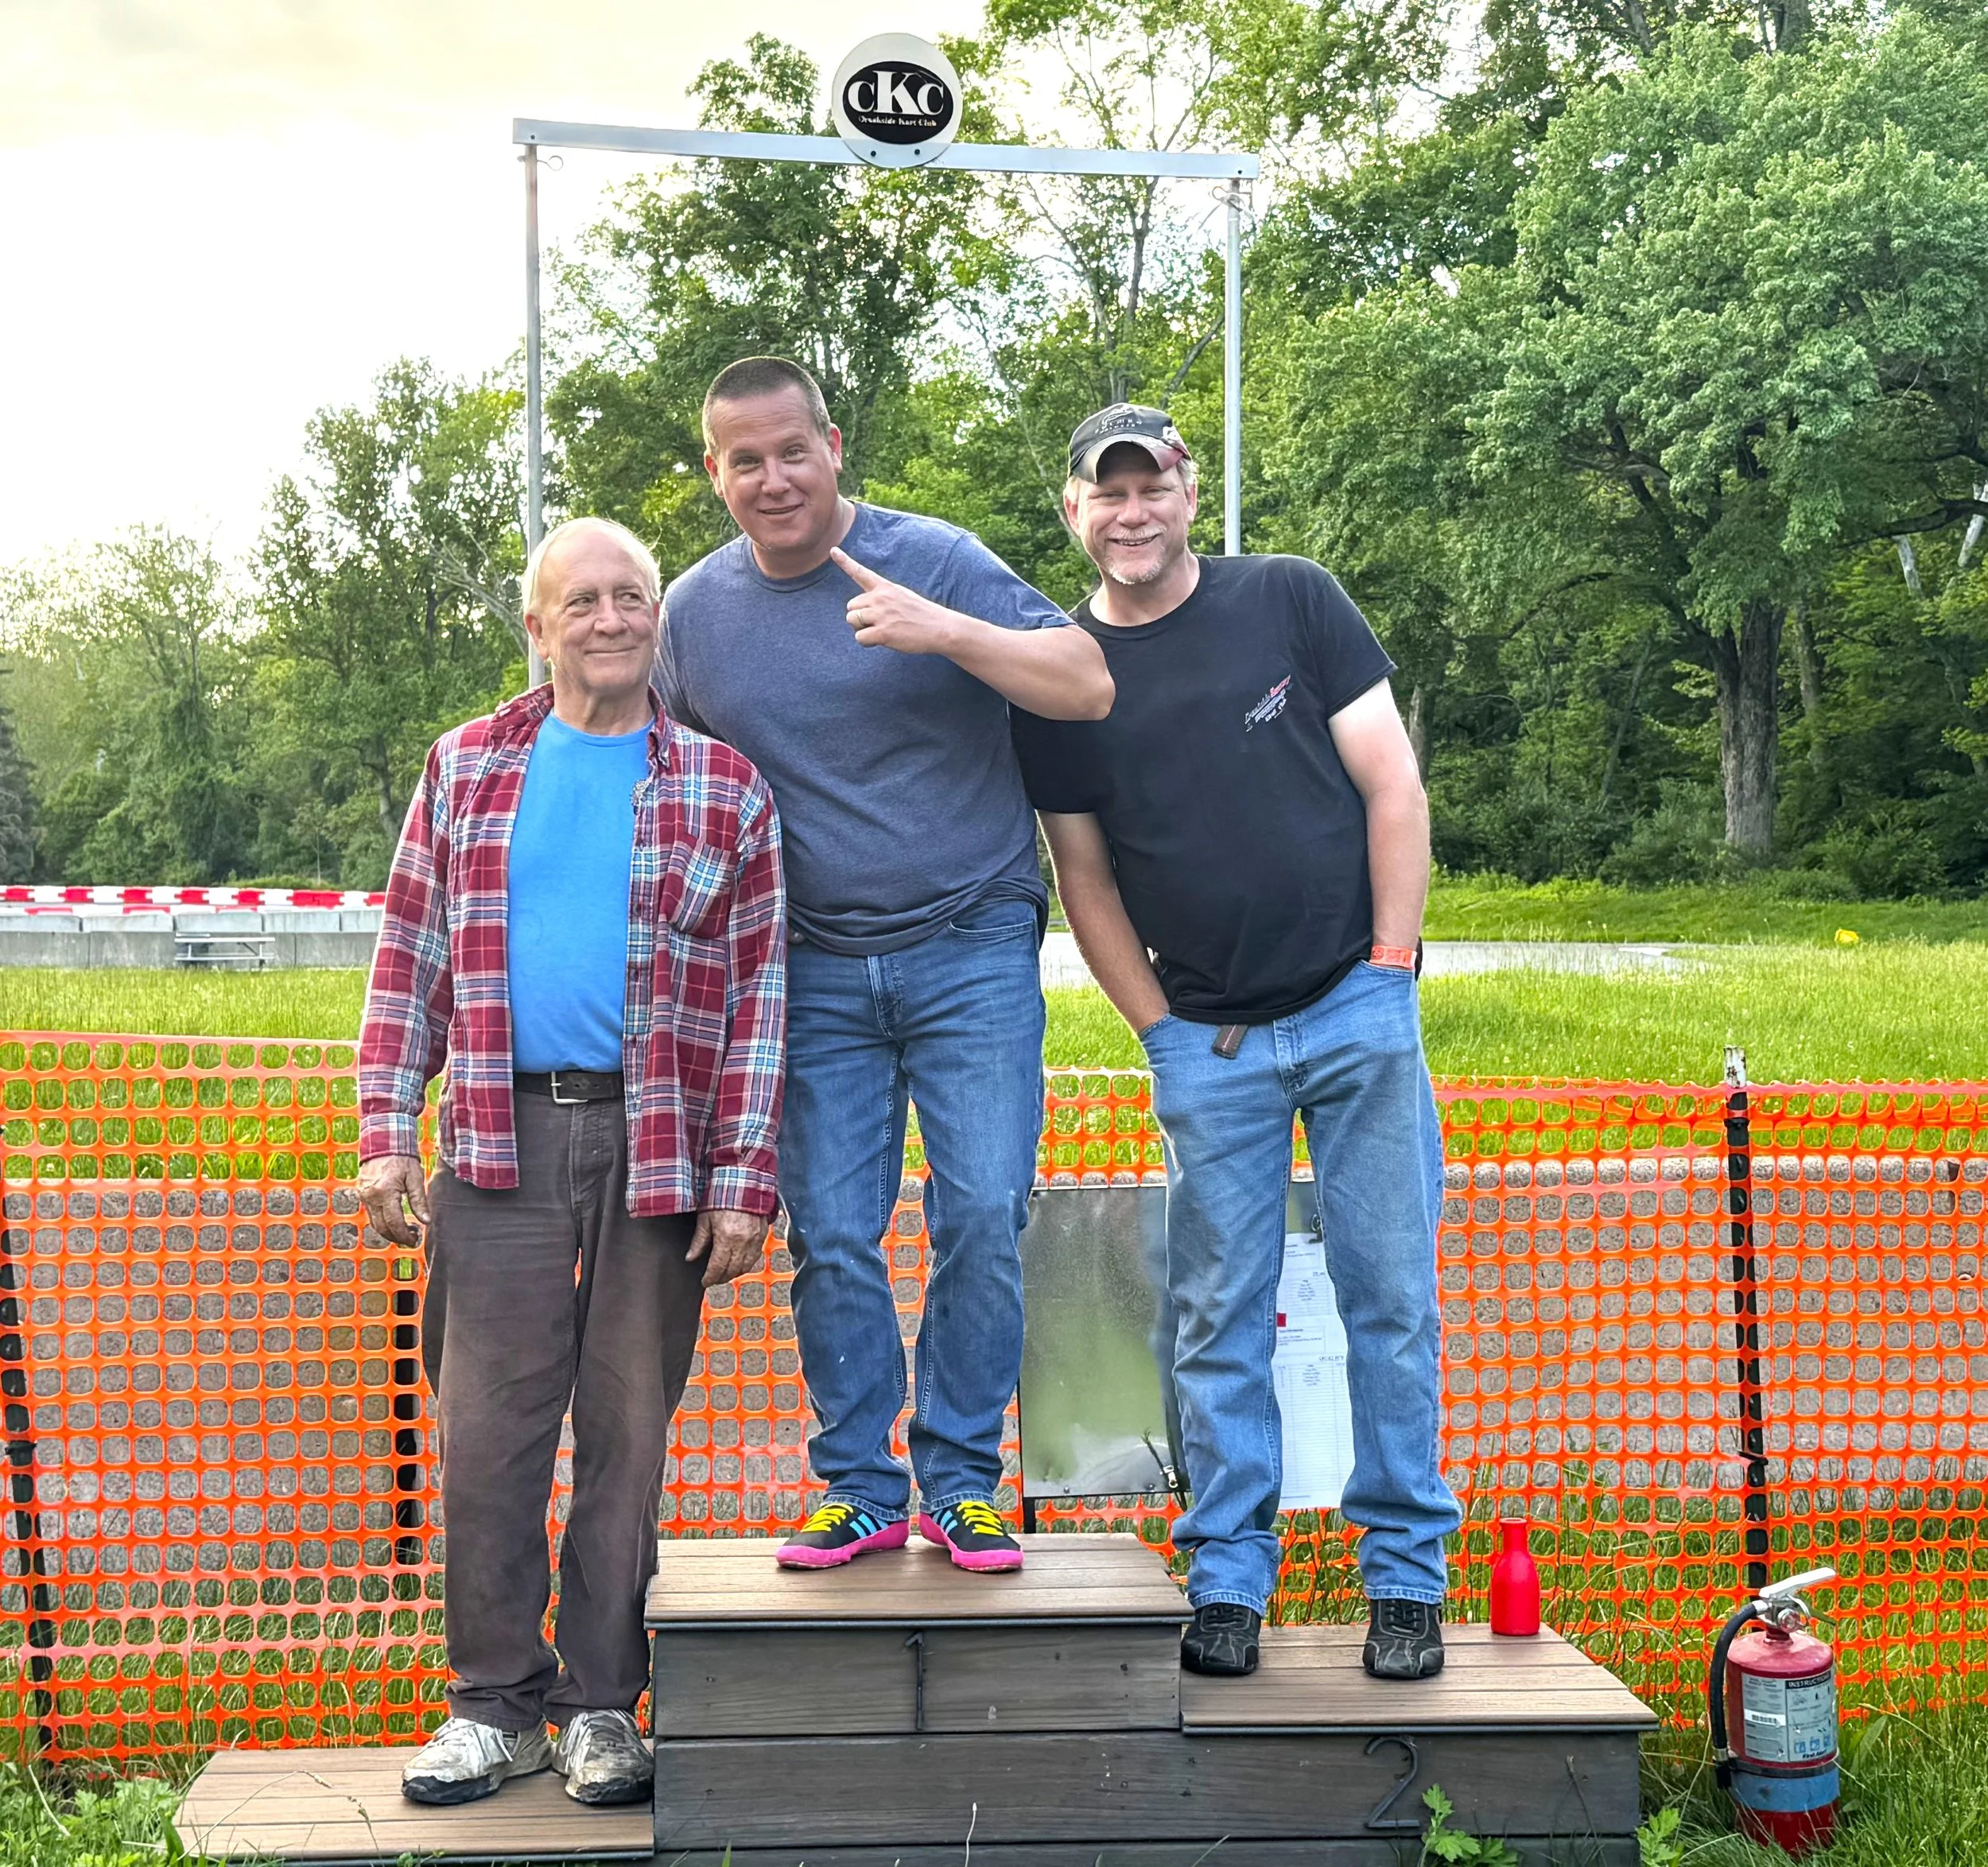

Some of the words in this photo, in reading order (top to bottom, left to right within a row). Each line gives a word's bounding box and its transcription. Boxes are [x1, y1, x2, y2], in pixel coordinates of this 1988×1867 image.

[899, 118, 916, 126] Kart
[905, 1632, 925, 1730] 1
[1364, 1737, 1419, 1827] 2
